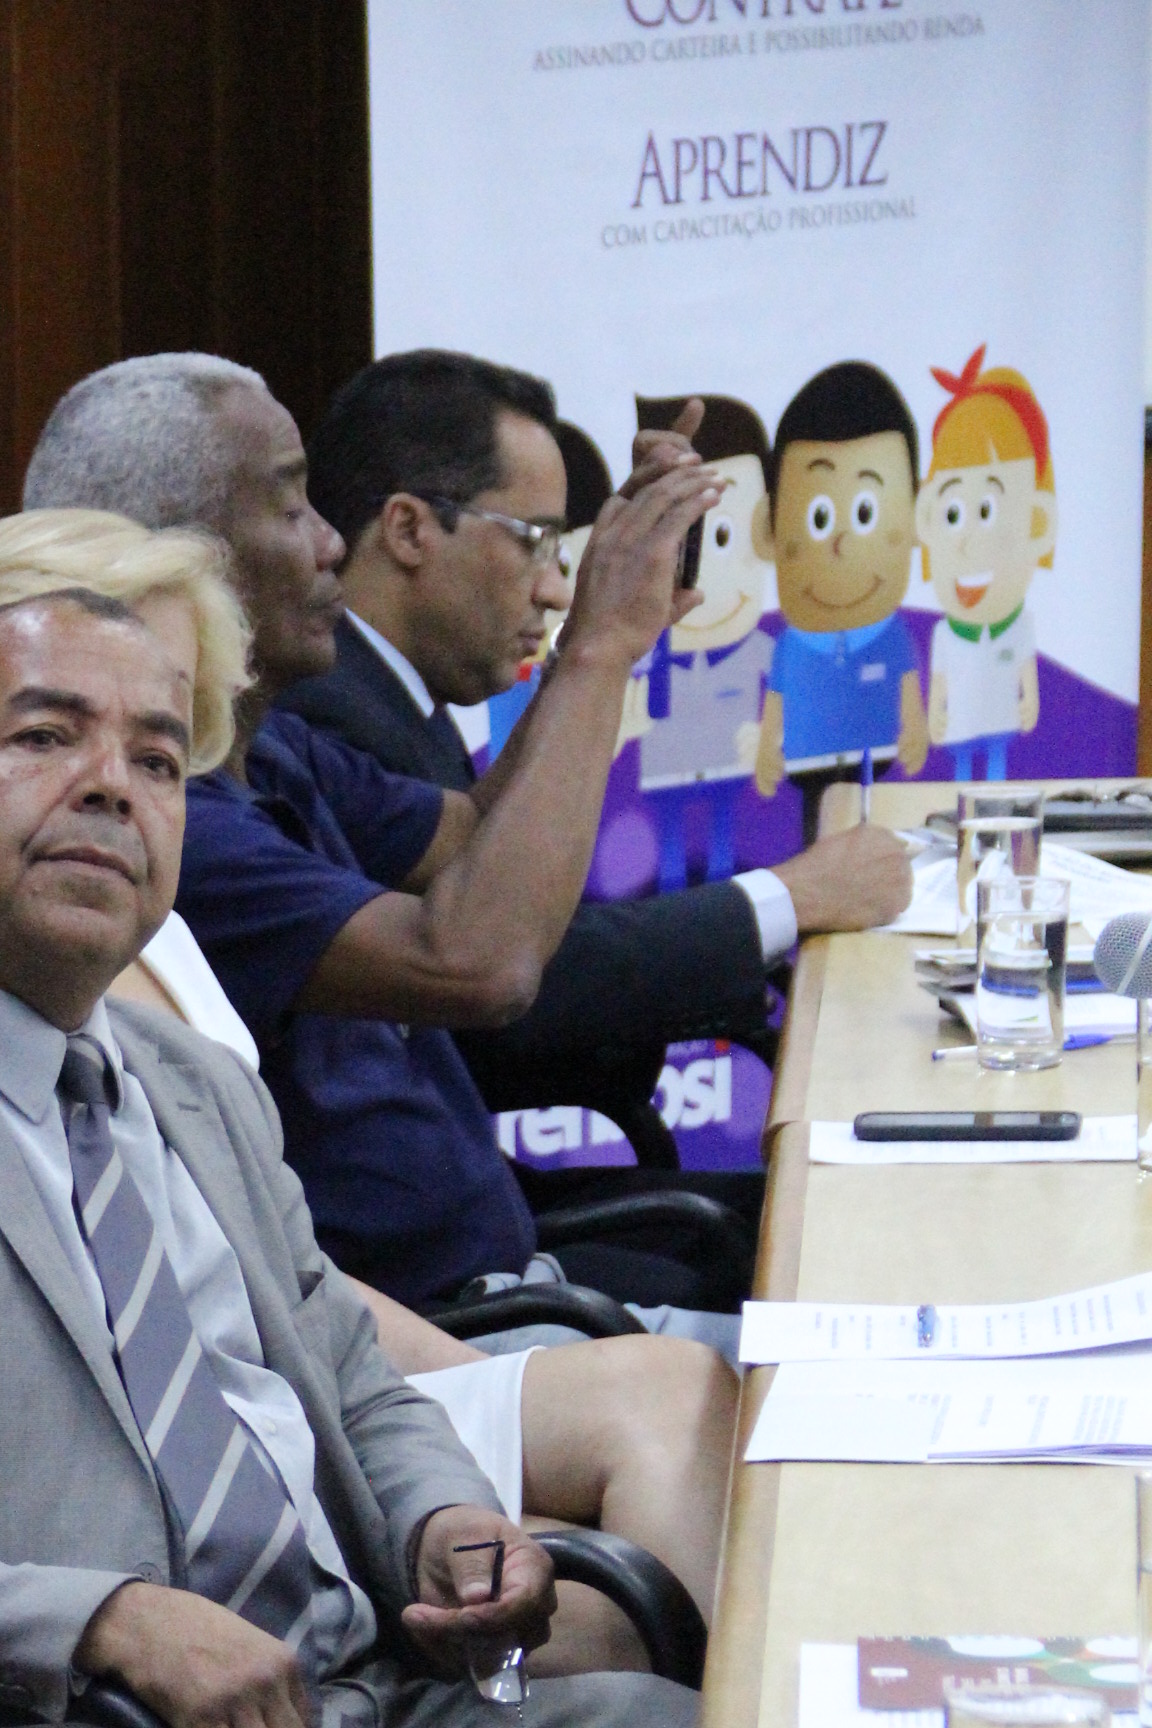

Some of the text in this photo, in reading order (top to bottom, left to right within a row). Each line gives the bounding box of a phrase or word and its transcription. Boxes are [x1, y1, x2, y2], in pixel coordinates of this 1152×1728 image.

[533, 41, 646, 71] ASSINANDO
[651, 34, 741, 62] CARTEIRA
[765, 19, 918, 51] POSSIBILITANDO
[924, 13, 985, 40] RENDA
[631, 119, 889, 209] APRENDIZ
[601, 195, 915, 249] COM CAPACITAÇÃO PROFISSIONAL
